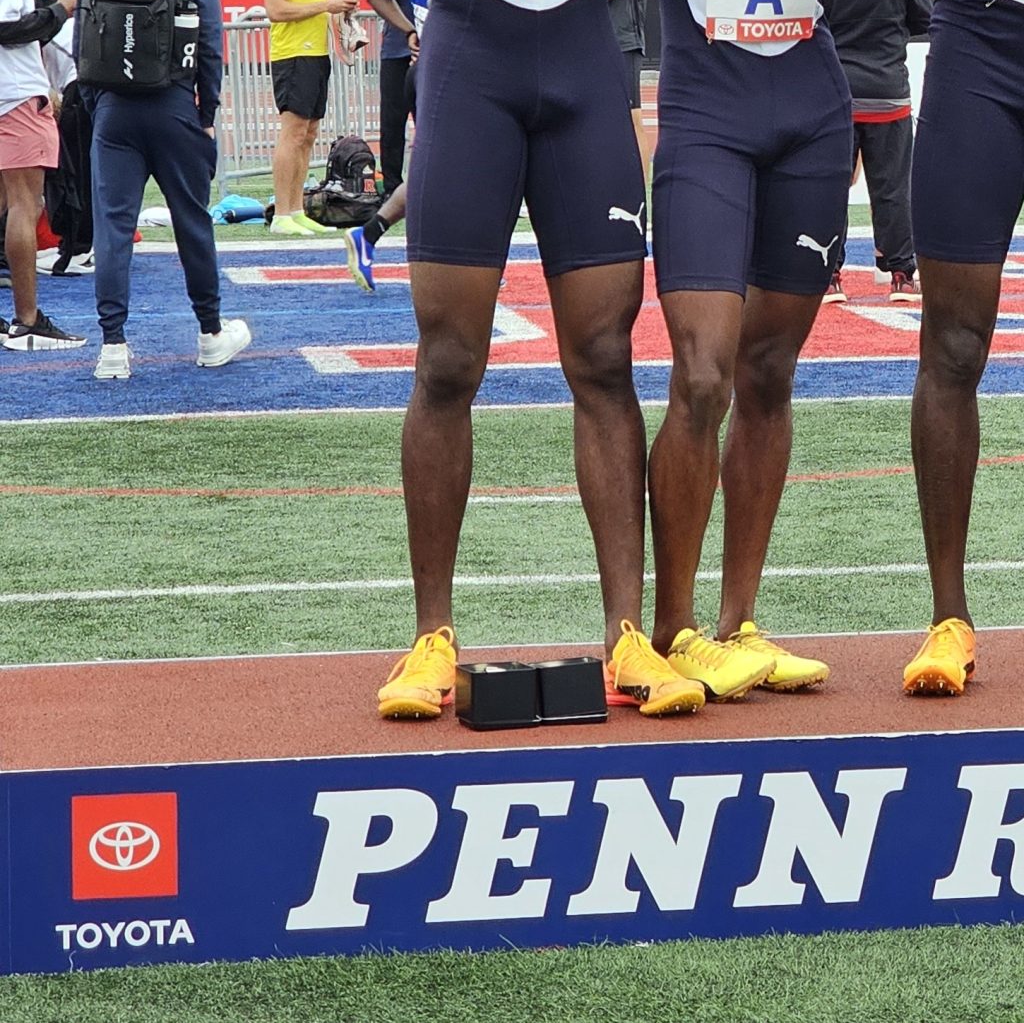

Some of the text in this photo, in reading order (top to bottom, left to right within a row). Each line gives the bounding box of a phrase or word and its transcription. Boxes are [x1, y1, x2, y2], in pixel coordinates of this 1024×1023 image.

[124, 13, 135, 53] Hyperice
[740, 22, 803, 38] TOYOTA
[285, 767, 908, 932] PENN
[55, 918, 195, 952] TOYOTA
